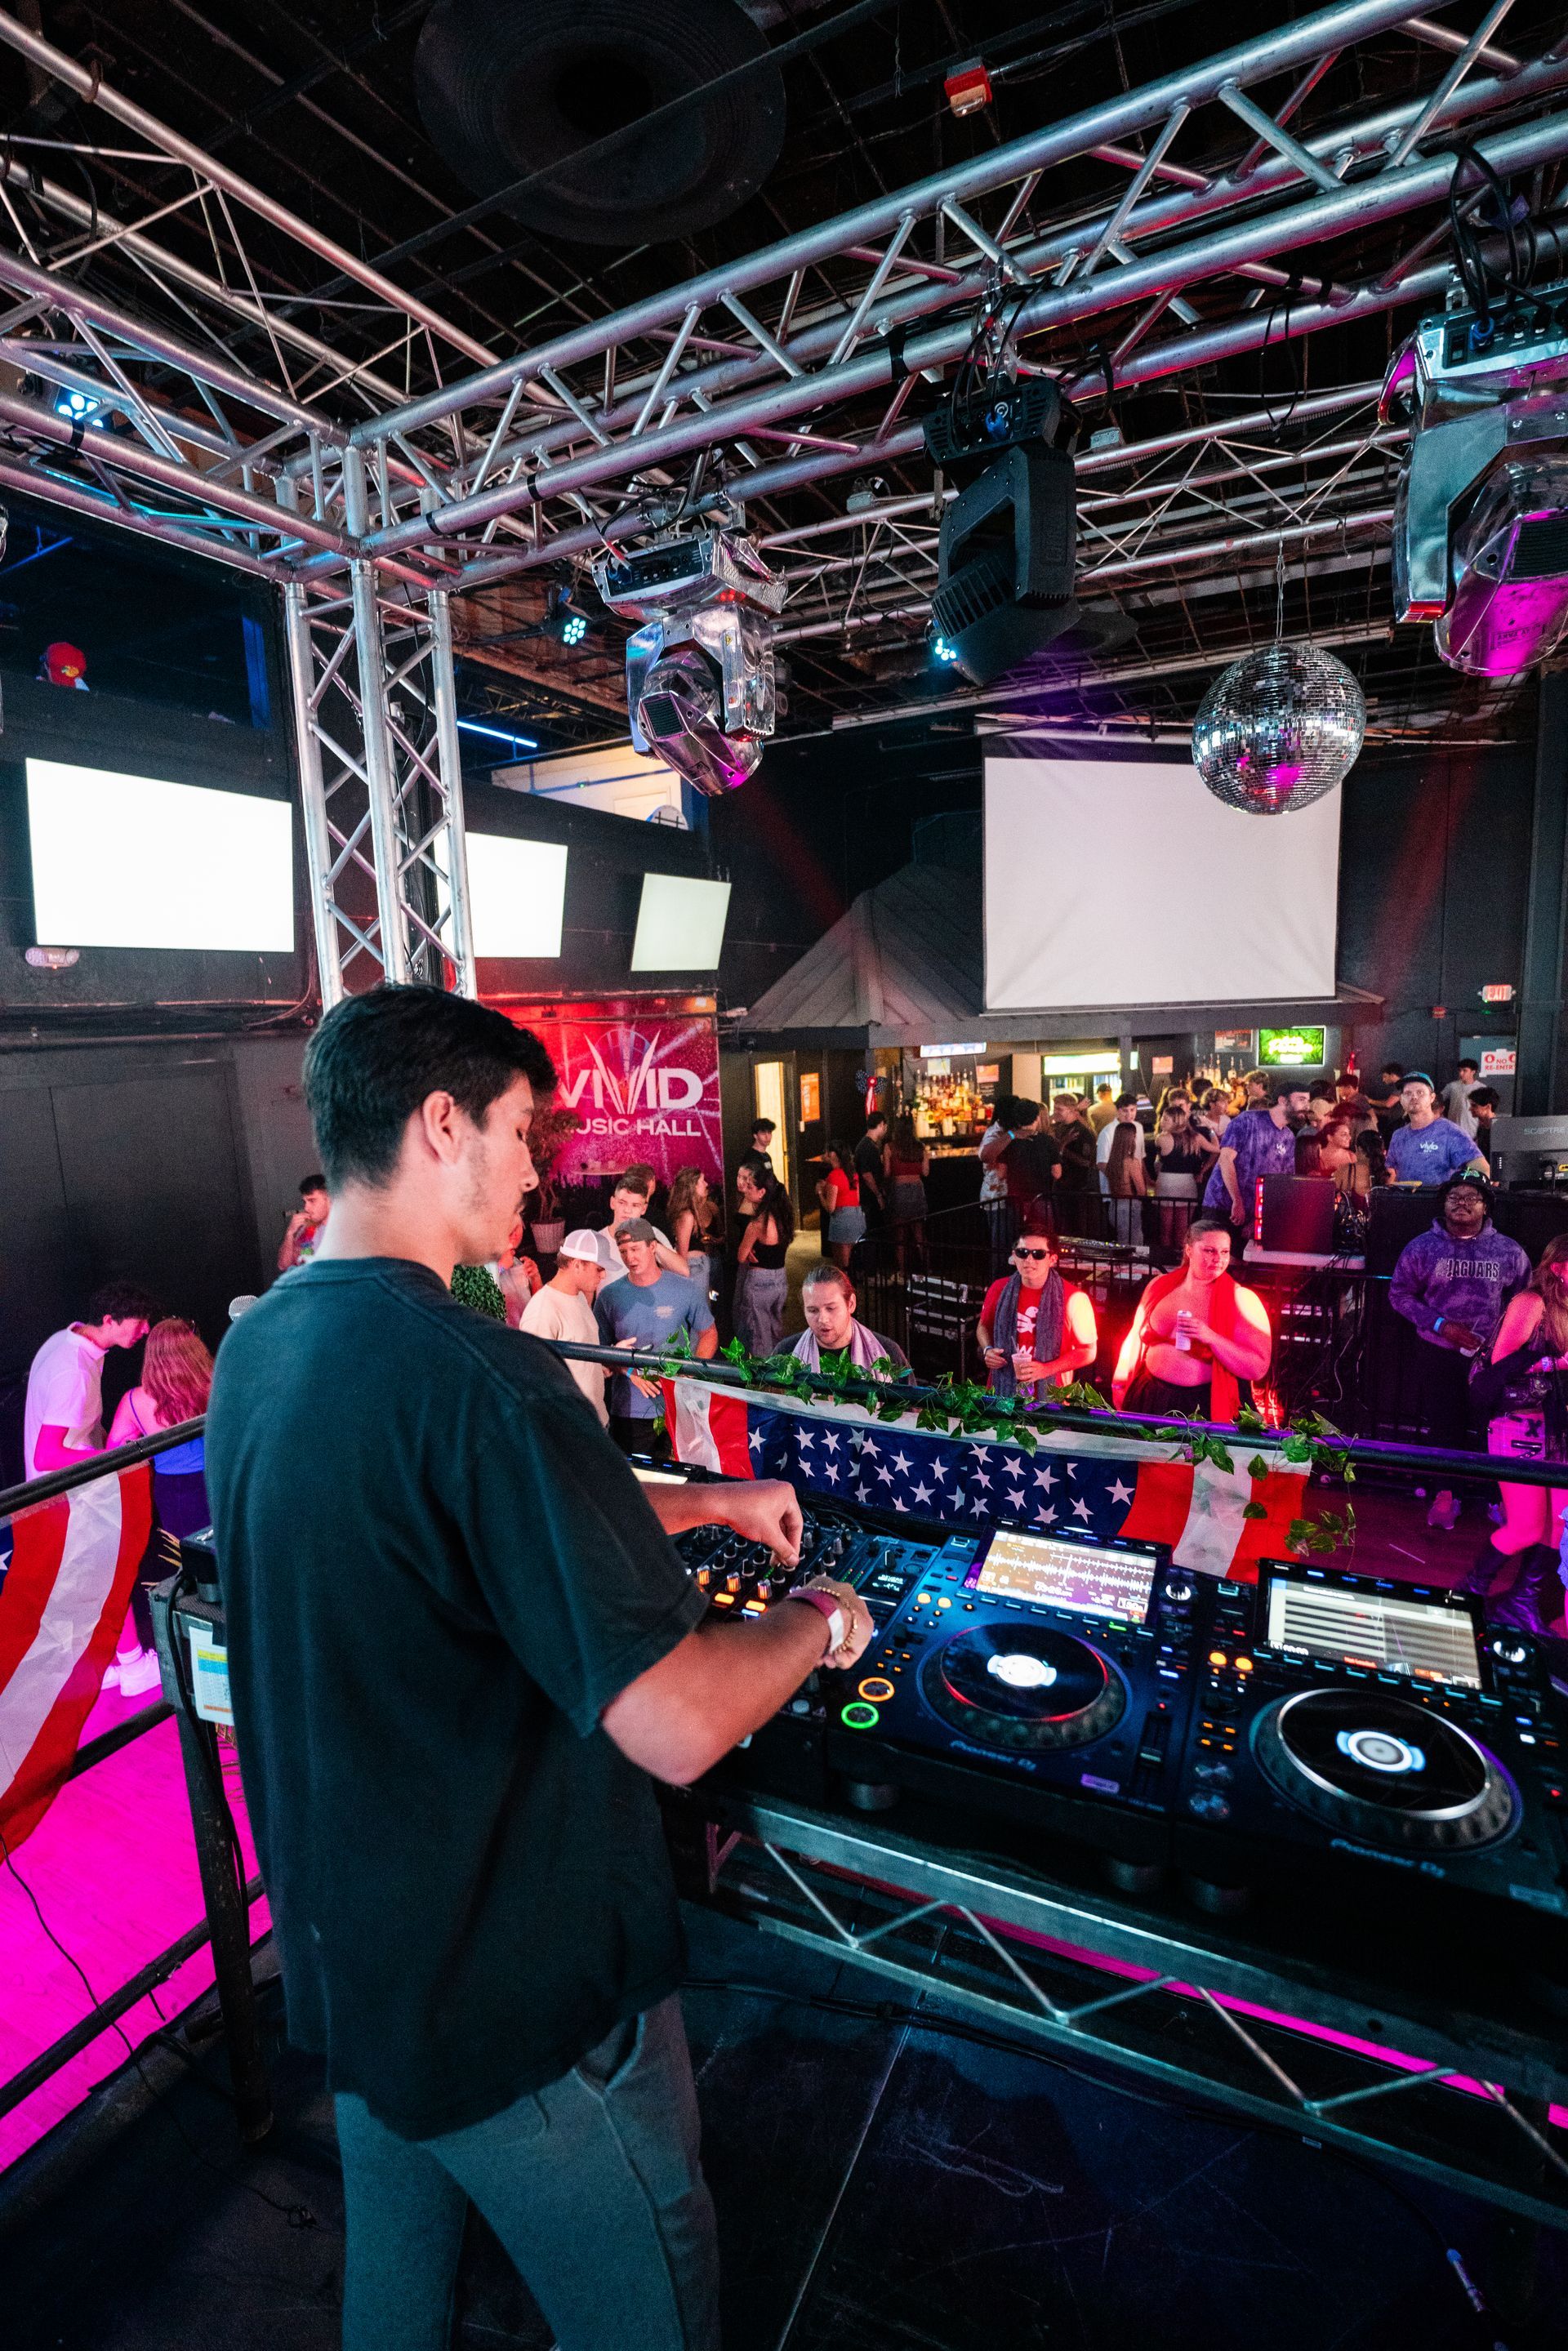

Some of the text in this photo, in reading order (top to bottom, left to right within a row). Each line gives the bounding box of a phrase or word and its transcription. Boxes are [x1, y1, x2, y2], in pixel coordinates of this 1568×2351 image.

[1487, 986, 1508, 1000] EXIT
[559, 1029, 703, 1115] VIVID
[571, 1118, 702, 1137] USIC HALL
[1447, 1258, 1499, 1278] JAGUARS
